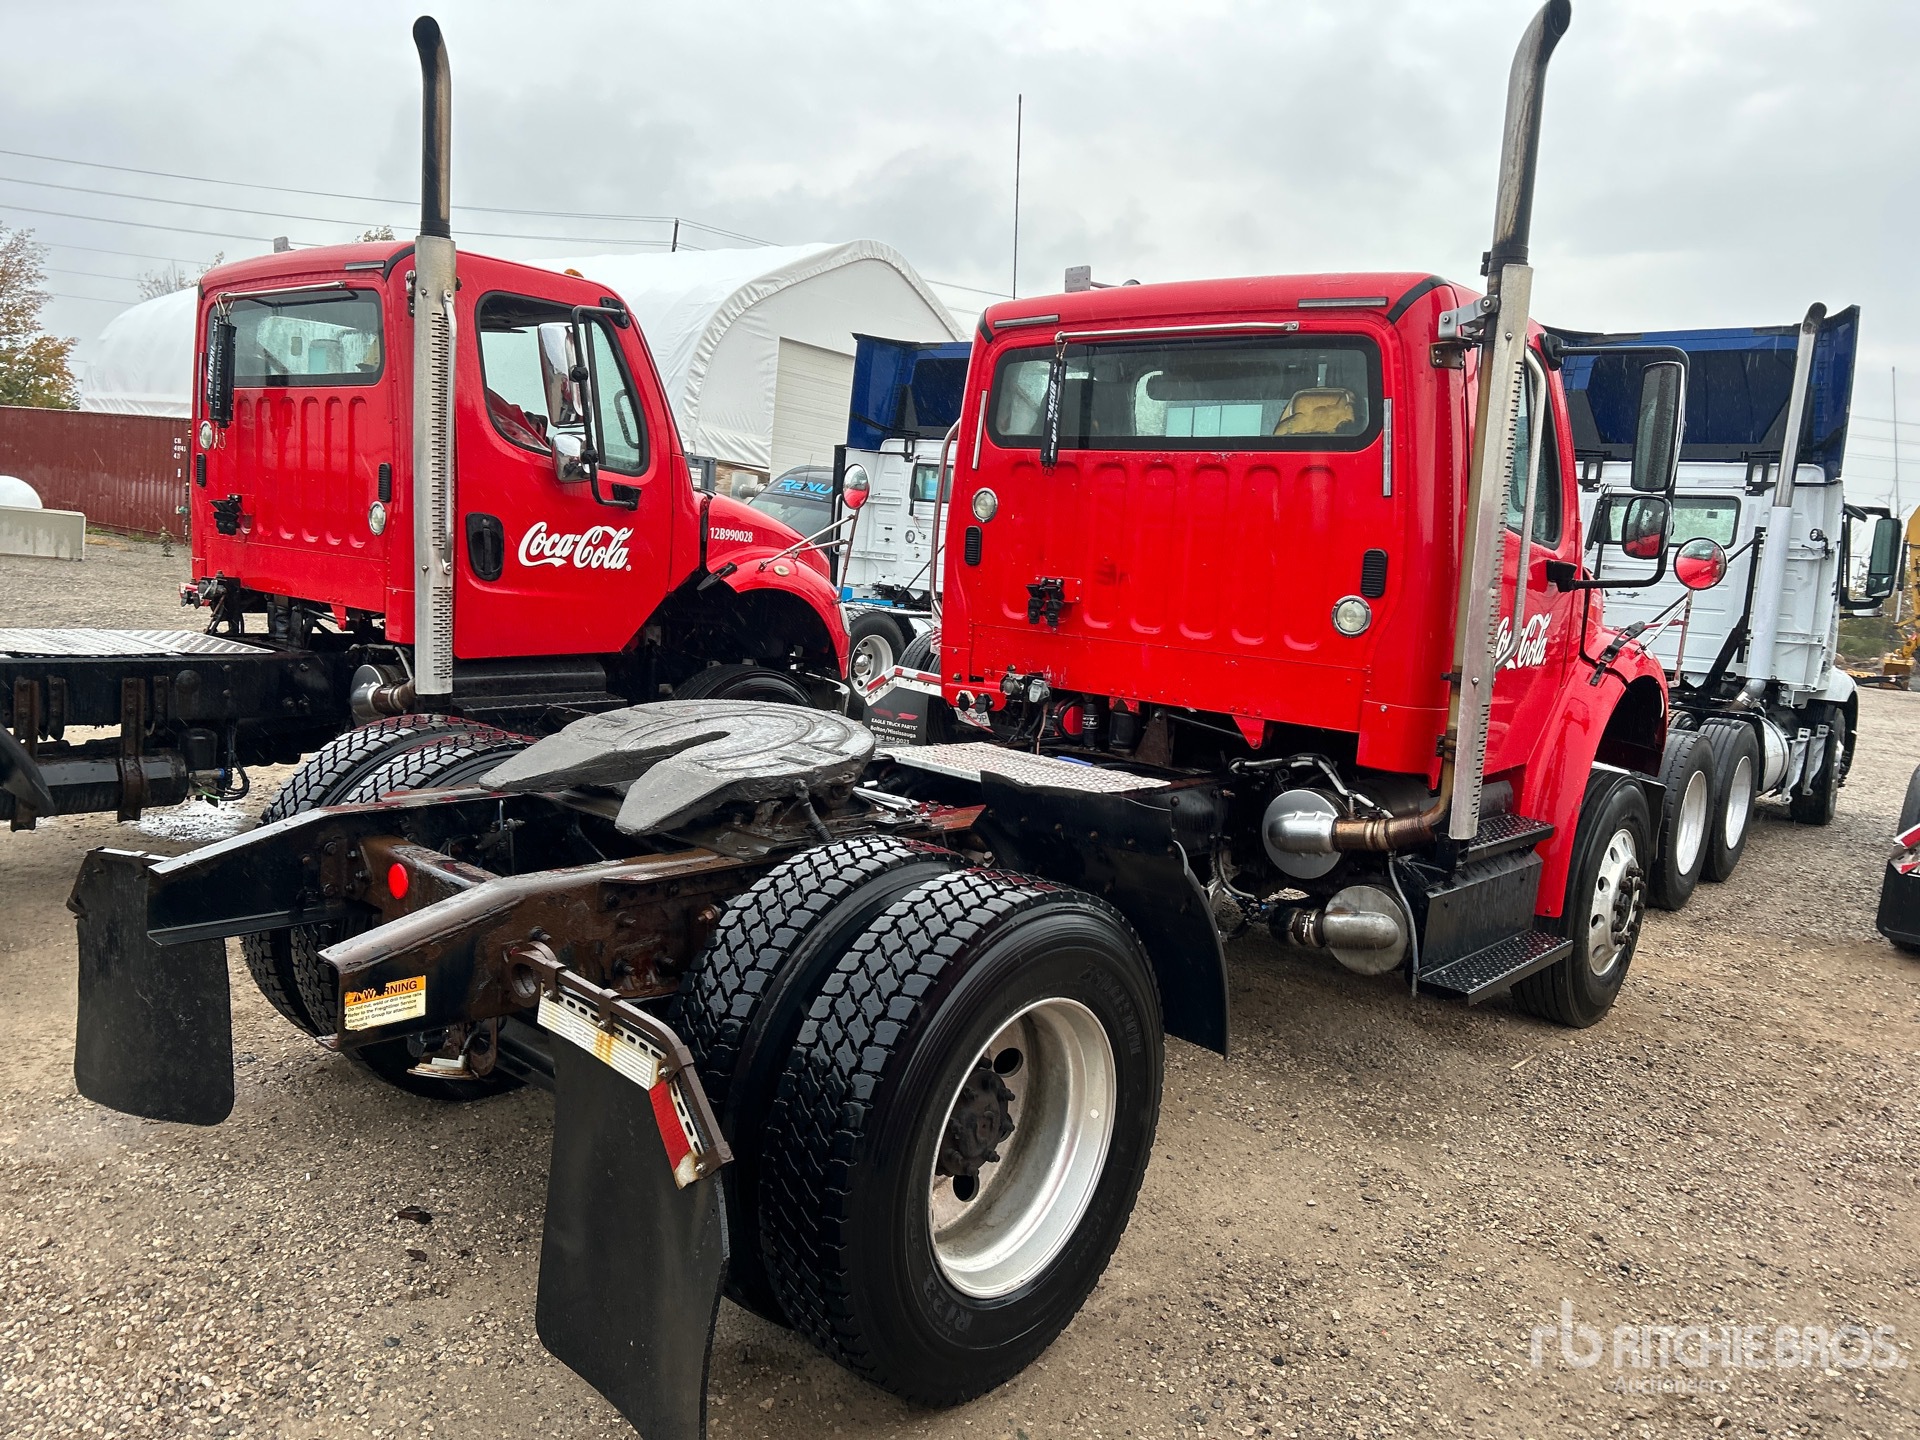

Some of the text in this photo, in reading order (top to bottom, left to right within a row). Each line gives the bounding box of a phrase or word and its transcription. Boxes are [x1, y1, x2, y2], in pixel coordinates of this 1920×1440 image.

[710, 527, 753, 543] 12B990028
[518, 521, 634, 570] Coca-Cola
[871, 717, 886, 725] EAGLE
[364, 981, 418, 1000] WRNING
